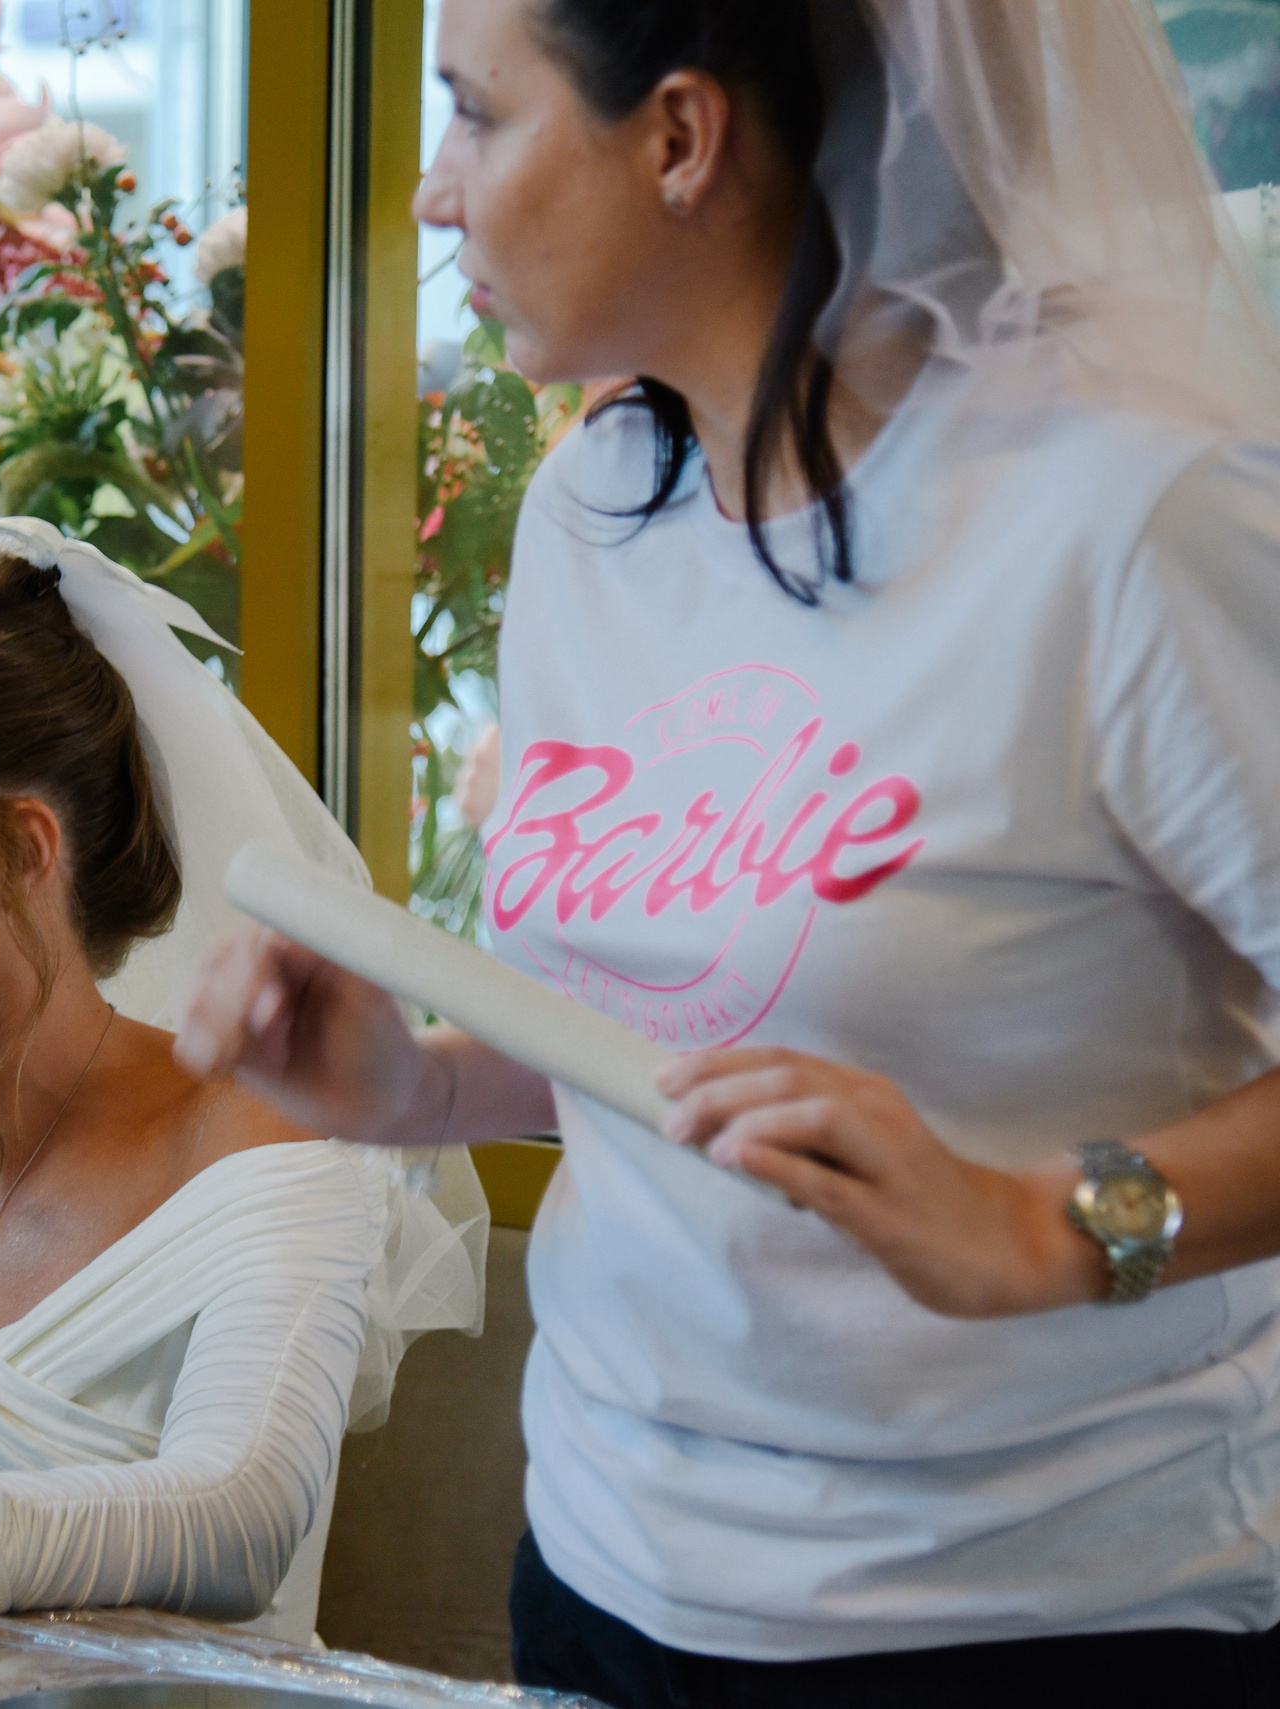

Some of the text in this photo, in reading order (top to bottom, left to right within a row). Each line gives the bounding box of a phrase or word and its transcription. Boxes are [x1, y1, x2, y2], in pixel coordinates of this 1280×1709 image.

[658, 680, 744, 745] COME
[484, 714, 928, 934] Barbie
[642, 998, 678, 1043] GO
[680, 962, 760, 1042] PARTY
